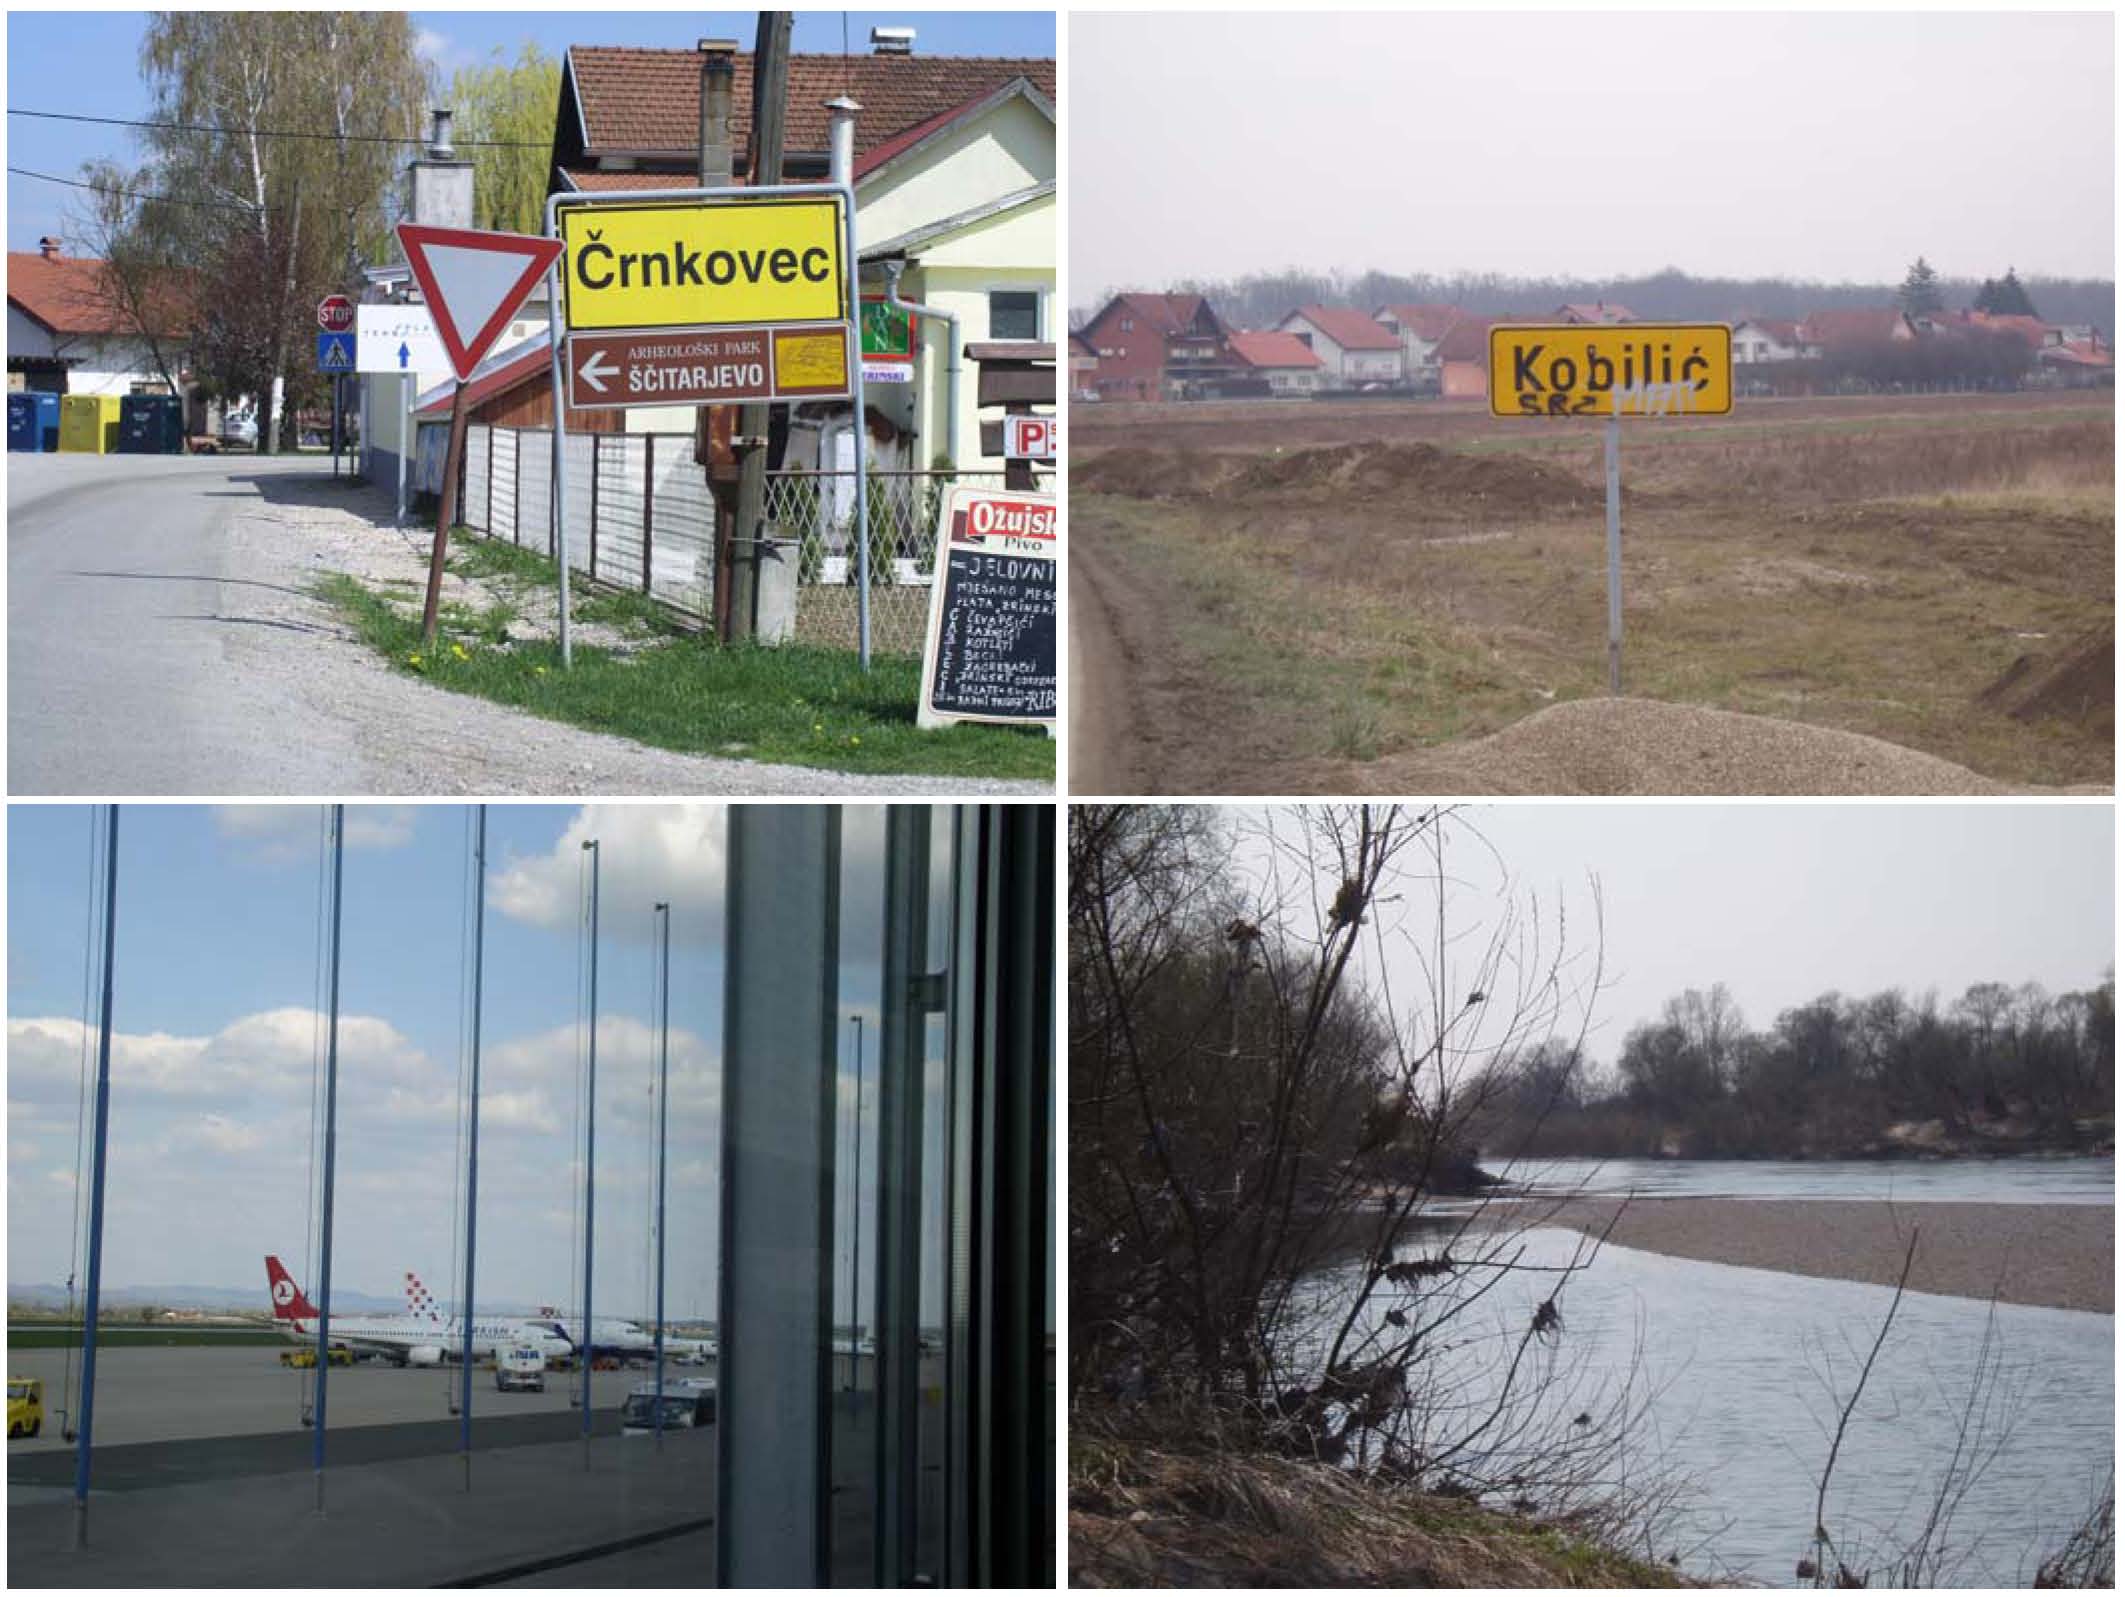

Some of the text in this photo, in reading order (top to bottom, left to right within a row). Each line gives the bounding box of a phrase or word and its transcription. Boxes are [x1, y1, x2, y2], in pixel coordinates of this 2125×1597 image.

[577, 229, 830, 290] Črnkovec
[320, 306, 351, 322] STOP
[628, 340, 761, 361] ARHEOLOŠKI PARK
[628, 363, 764, 393] ŠČITARJEVO
[1513, 344, 1709, 392] Kobilić
[1021, 423, 1043, 453] P
[1005, 534, 1043, 551] Pivo
